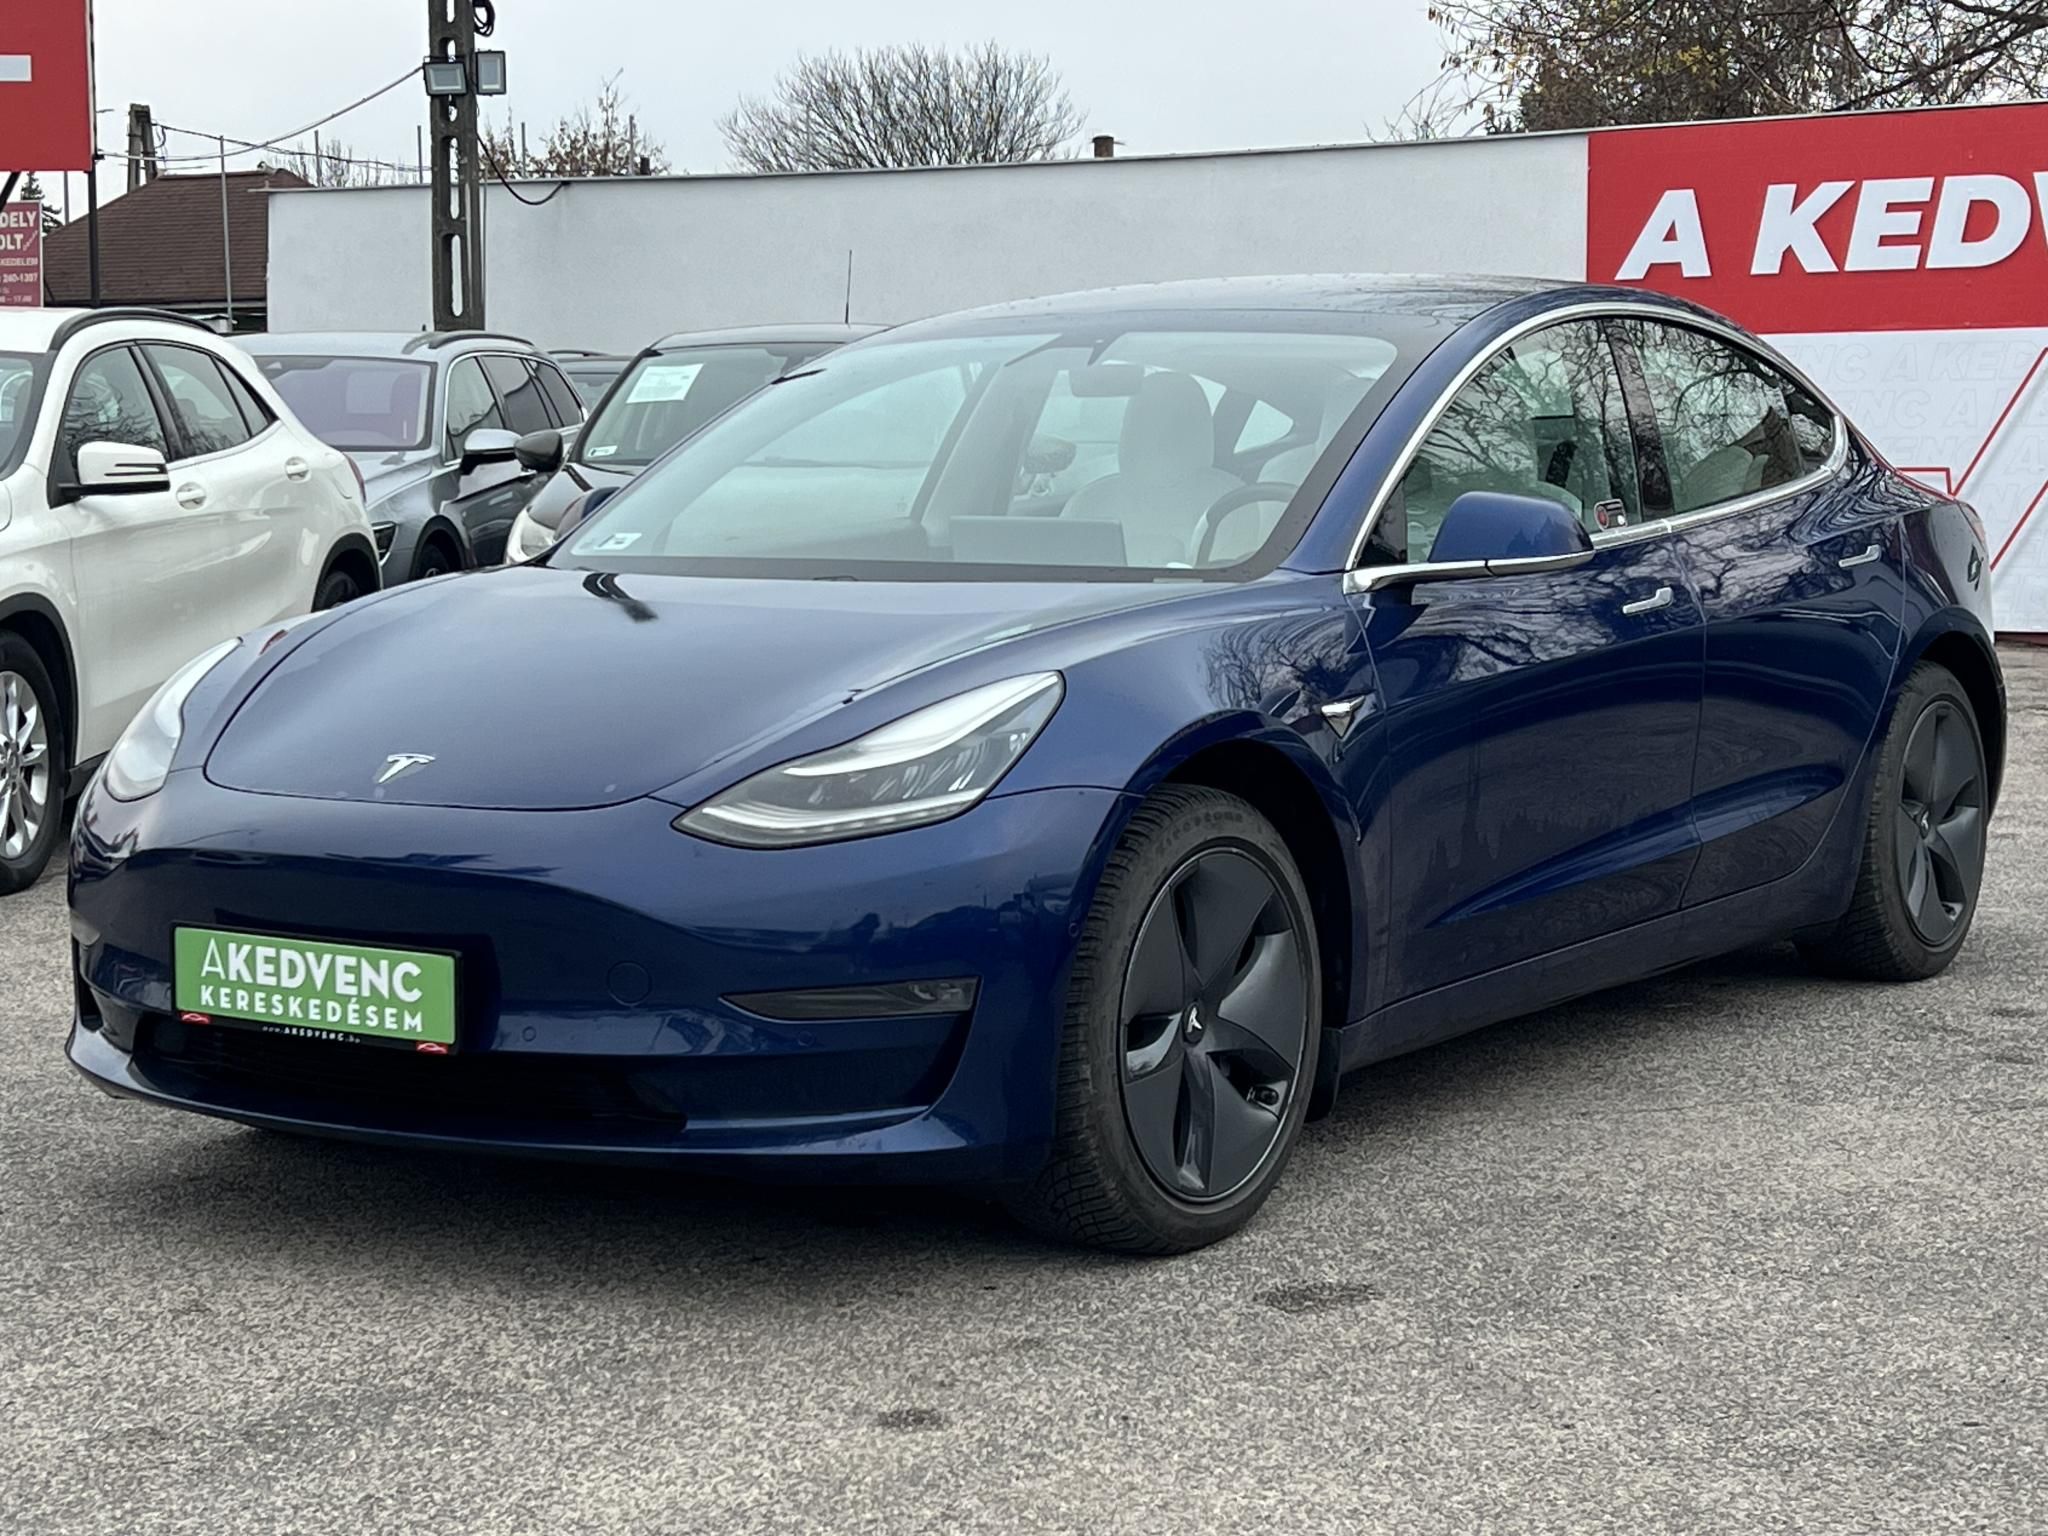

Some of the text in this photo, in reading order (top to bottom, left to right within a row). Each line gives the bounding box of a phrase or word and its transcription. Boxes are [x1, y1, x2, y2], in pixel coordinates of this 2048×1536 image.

[1614, 188, 1712, 281] A
[201, 938, 422, 1002] AKEDVENC
[201, 985, 423, 1032] KERESKEDÉSEM
